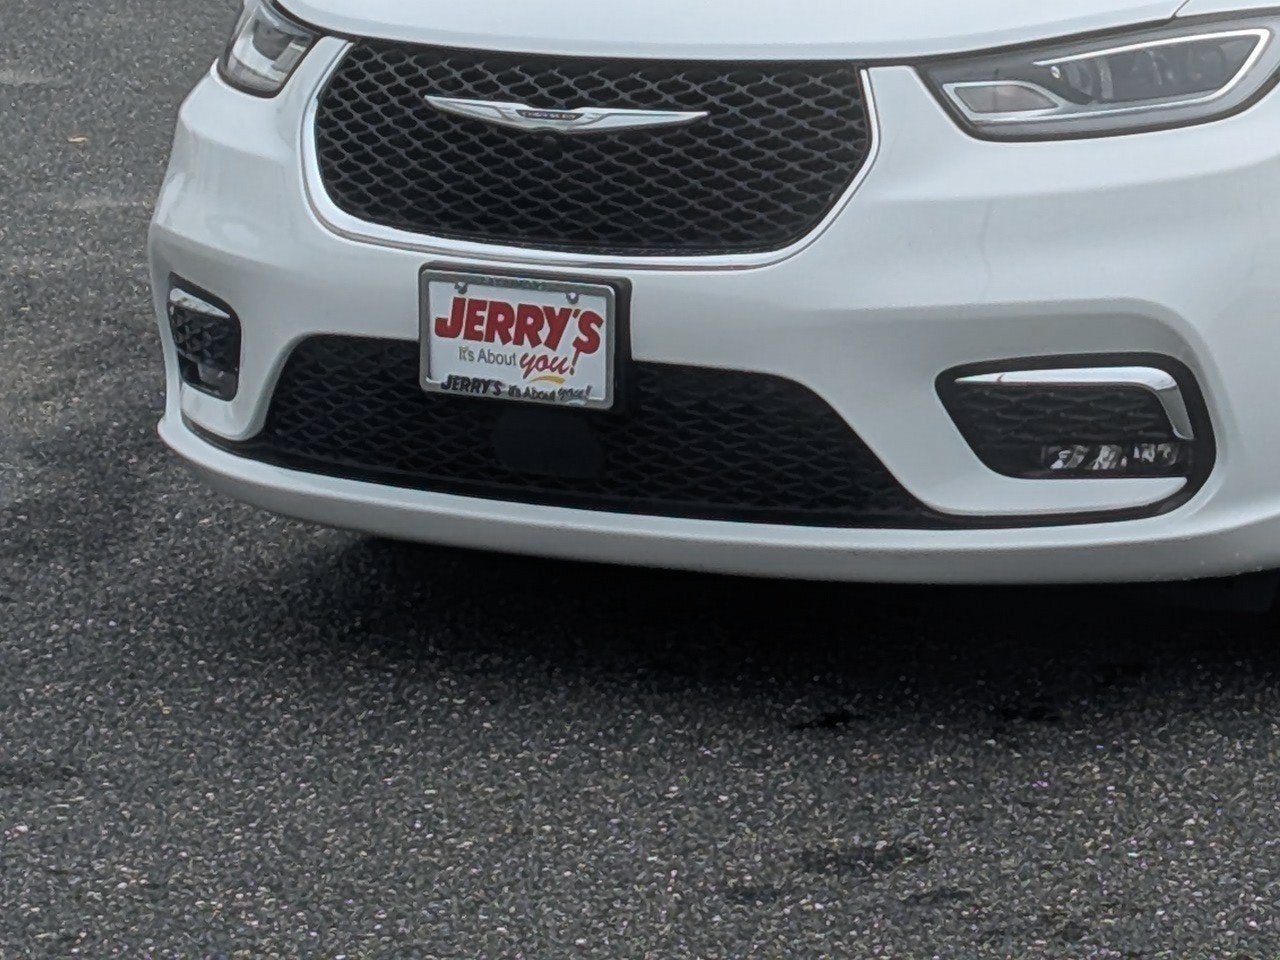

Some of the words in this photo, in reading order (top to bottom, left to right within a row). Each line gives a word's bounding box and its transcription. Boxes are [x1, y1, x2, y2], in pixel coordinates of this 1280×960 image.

[434, 296, 604, 355] JERRY'S
[458, 345, 475, 362] It's
[477, 348, 517, 366] About
[519, 350, 581, 380] you!
[440, 374, 504, 397] JERRY'S
